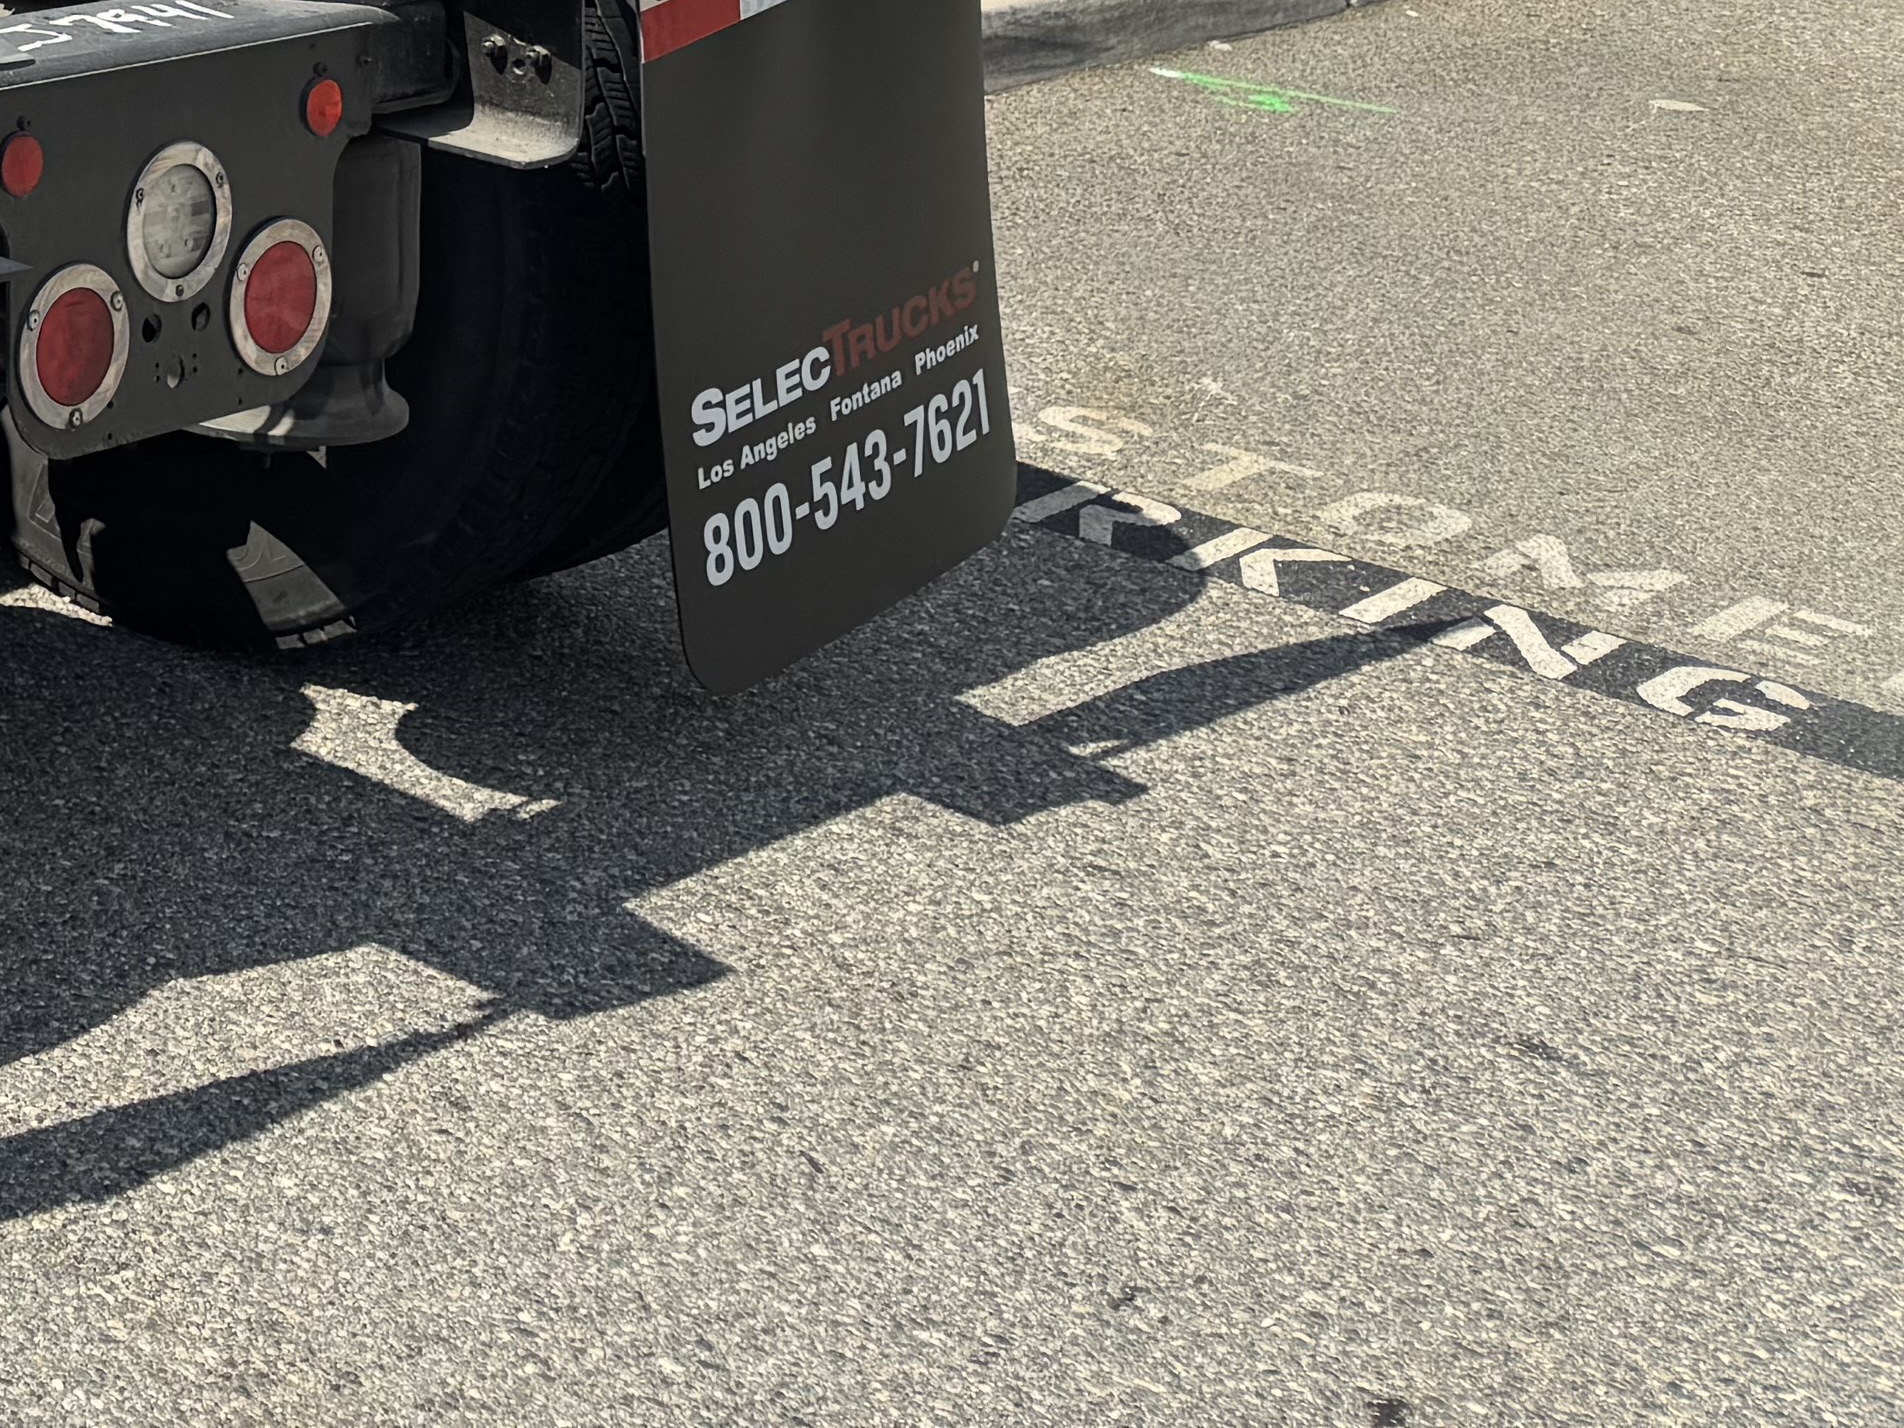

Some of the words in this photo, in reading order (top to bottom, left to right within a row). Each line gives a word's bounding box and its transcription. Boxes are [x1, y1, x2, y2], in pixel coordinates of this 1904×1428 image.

[698, 458, 734, 490] Los
[739, 415, 817, 471] Angeles
[829, 369, 903, 422] Fontana
[914, 322, 980, 376] Phoenix
[702, 367, 991, 587] 800-543-7621
